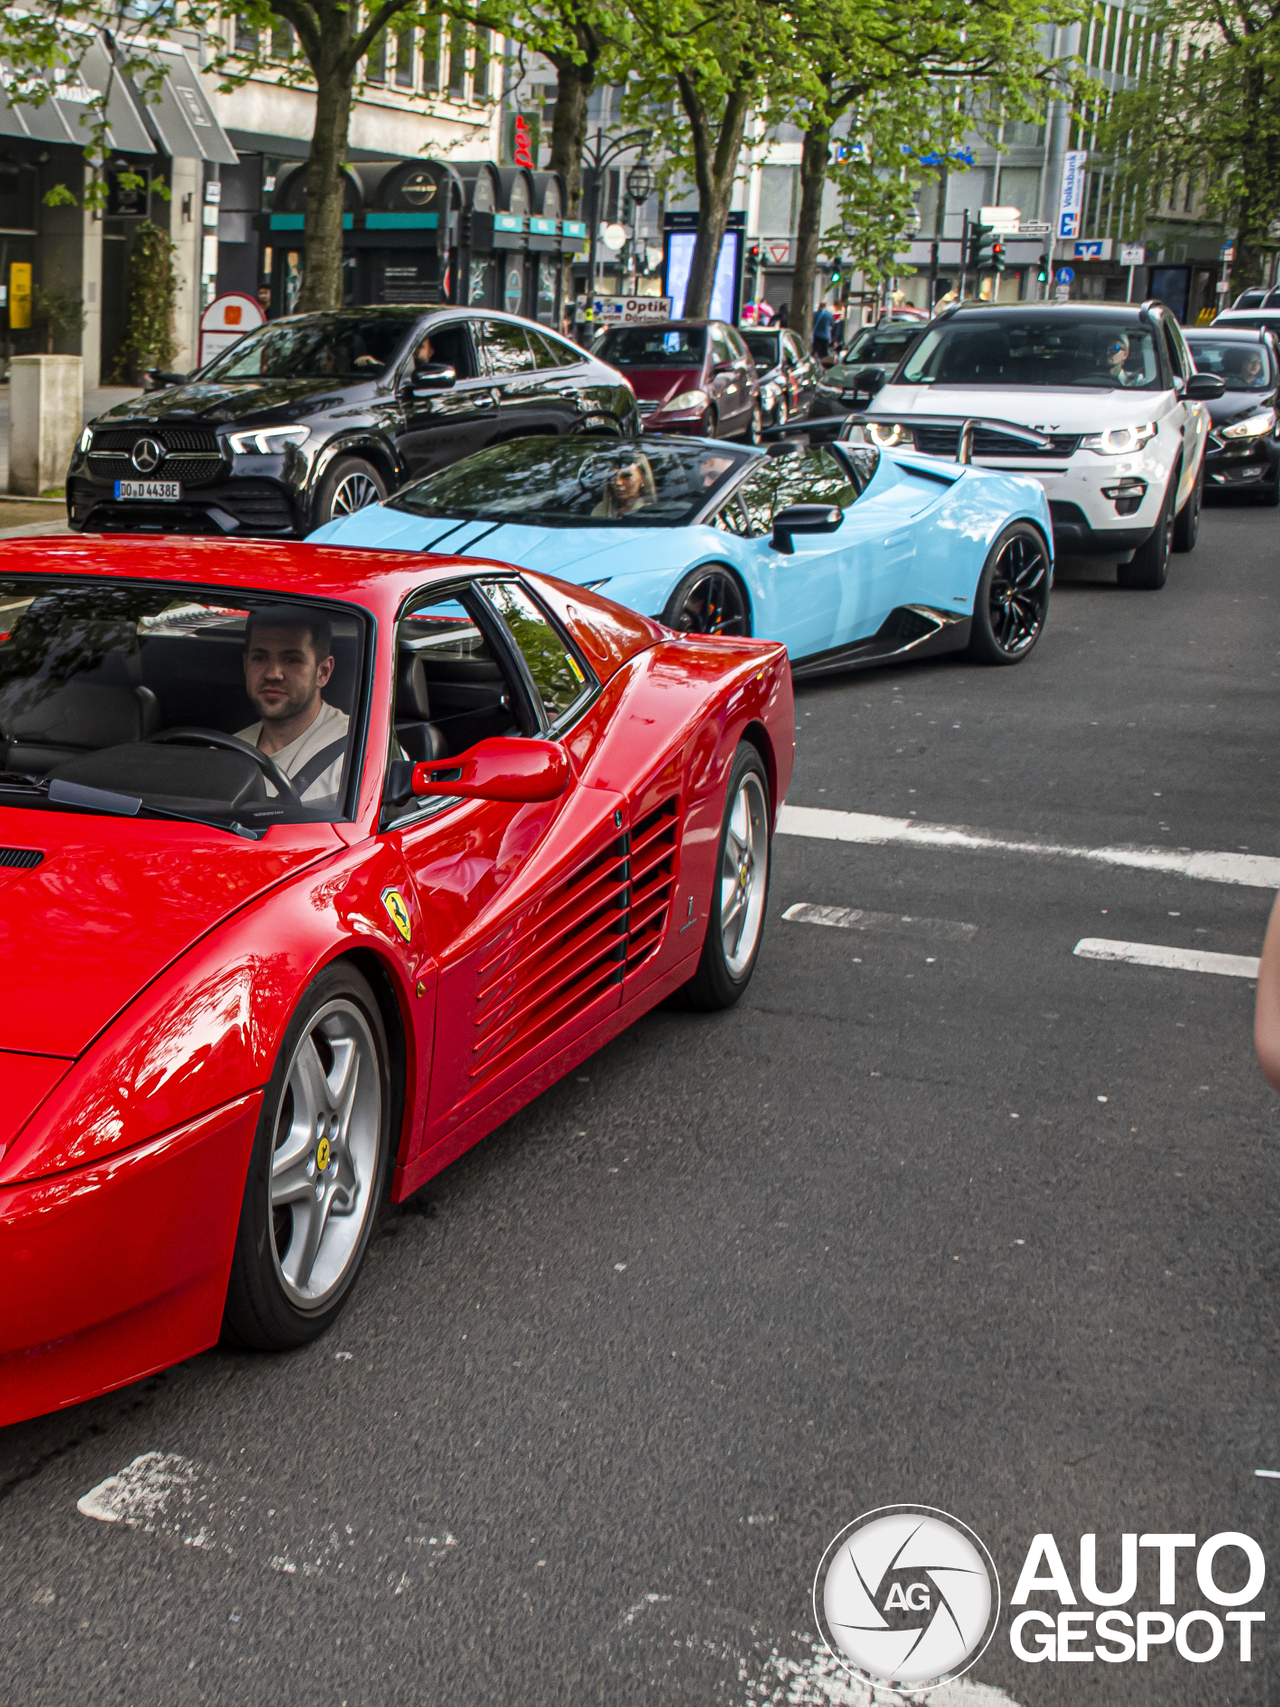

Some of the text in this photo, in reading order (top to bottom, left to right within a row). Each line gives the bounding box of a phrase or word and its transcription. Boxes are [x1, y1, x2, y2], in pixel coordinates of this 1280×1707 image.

[1063, 154, 1077, 208] Volksbank
[626, 300, 667, 314] Optik
[121, 483, 178, 497] DO D 4438E
